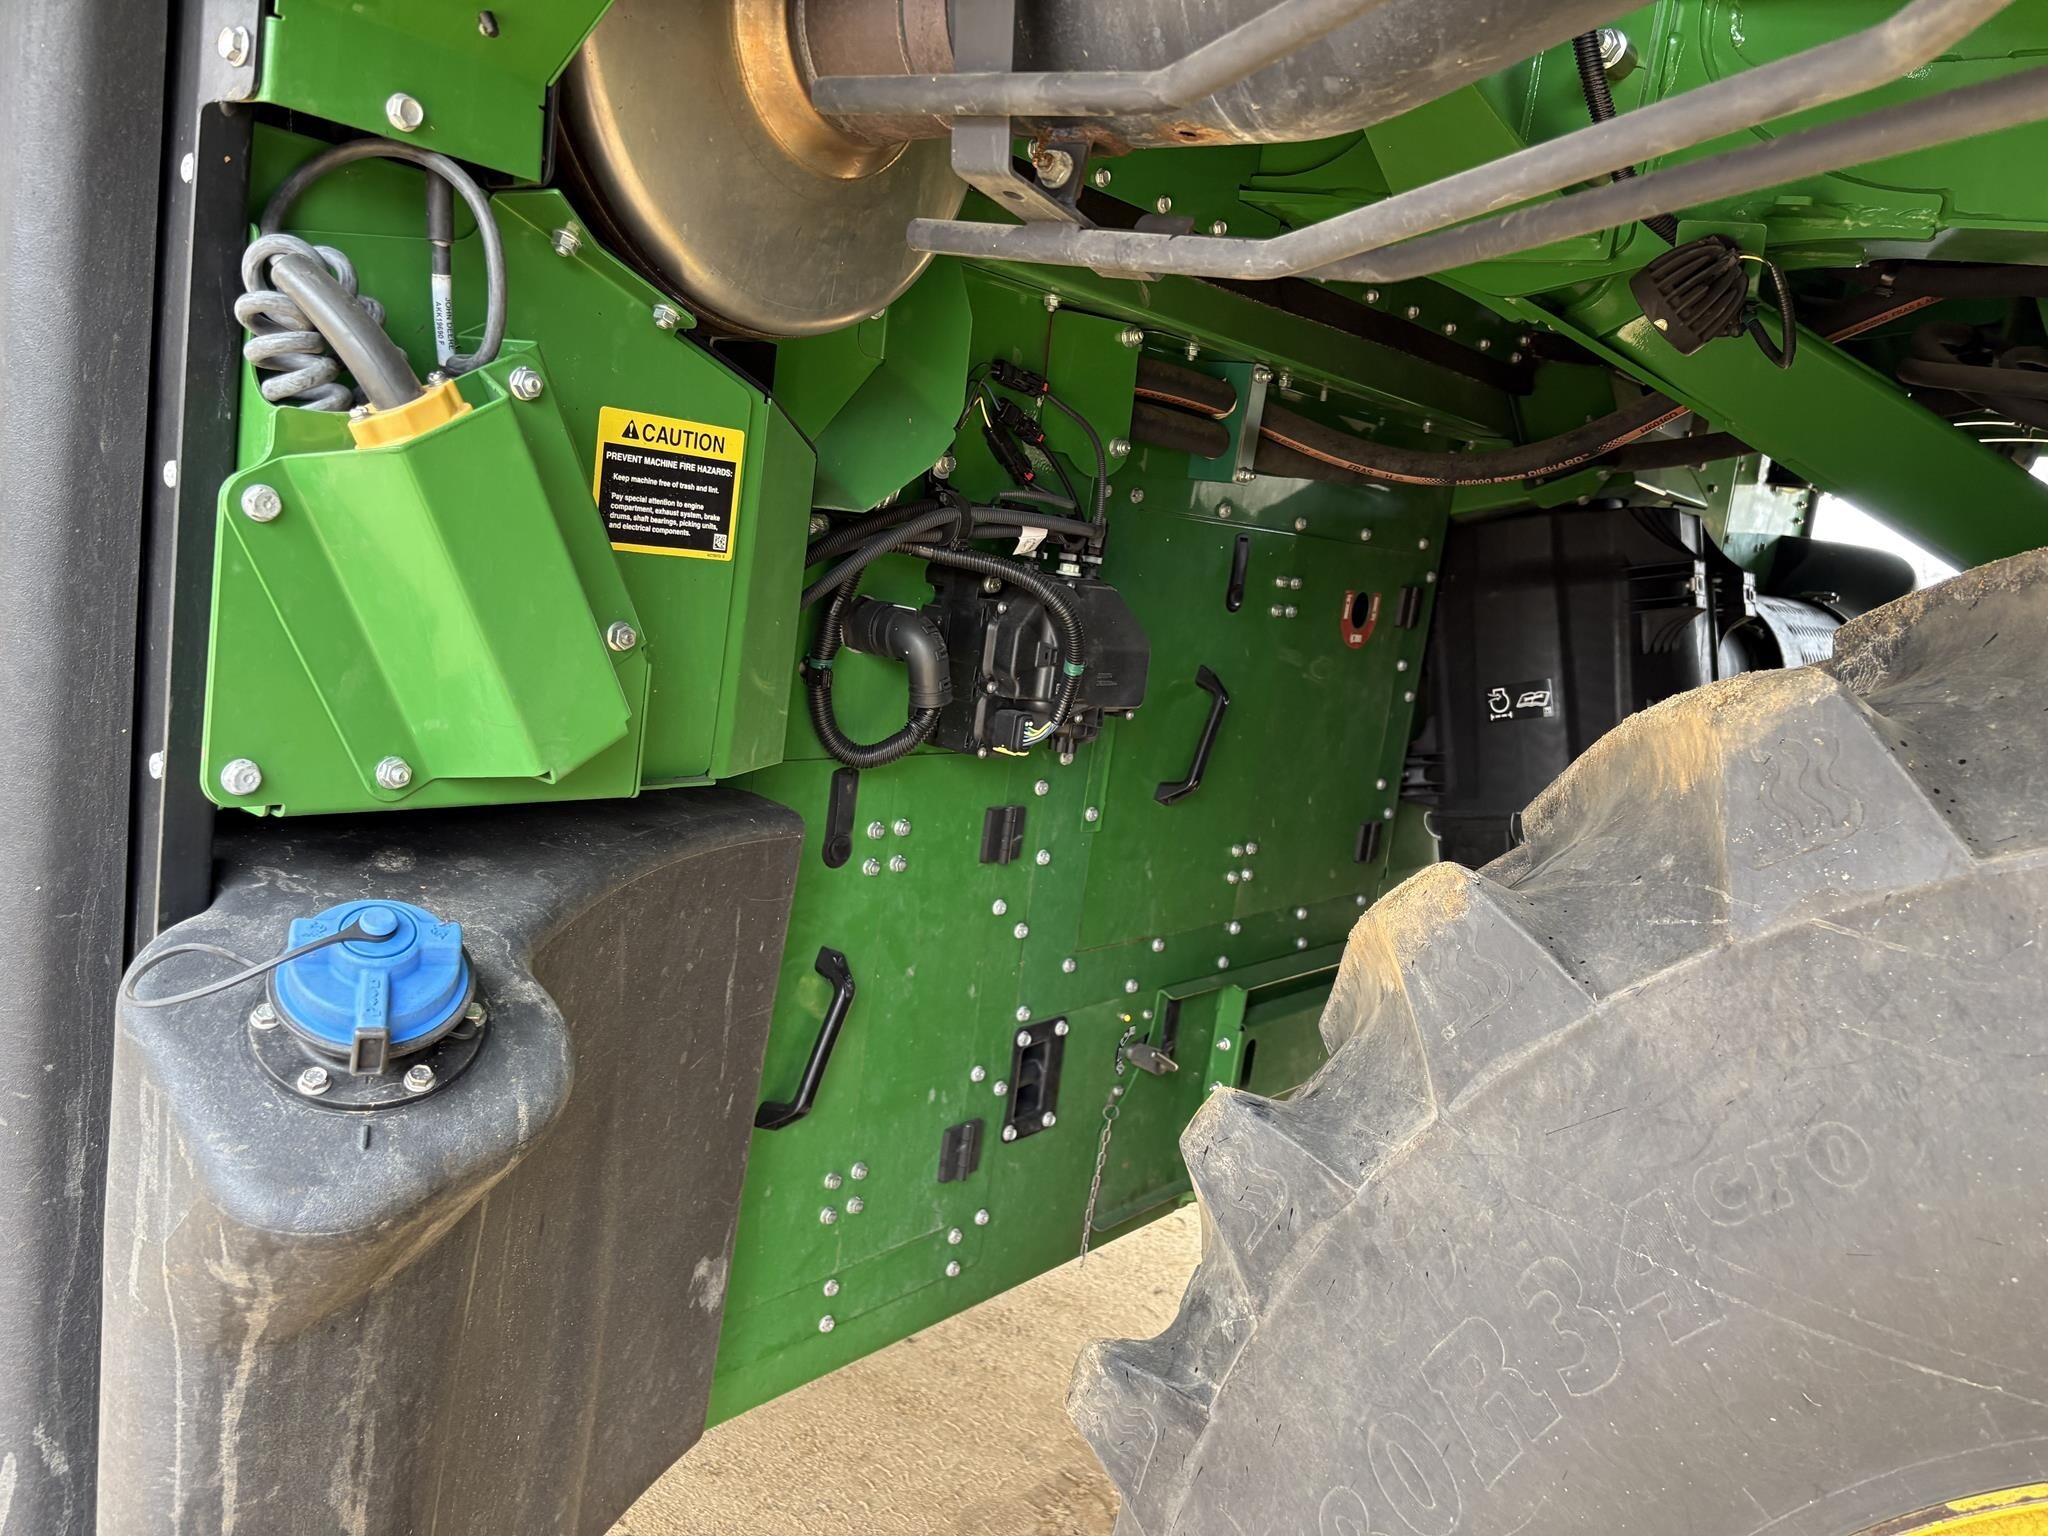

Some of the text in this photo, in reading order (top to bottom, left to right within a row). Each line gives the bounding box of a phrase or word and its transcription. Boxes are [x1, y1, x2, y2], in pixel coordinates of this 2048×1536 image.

[642, 423, 725, 454] CAUTION
[606, 450, 733, 478] PREVENT MACHINE FIRE HAZARDS:
[612, 472, 720, 495] Keep machine free of trash and lint.
[611, 491, 705, 511] Pay special attention to engine
[609, 511, 719, 532] drums, shaft bearings, picking units,
[610, 502, 721, 522] compartment, exhaust system, brake
[608, 521, 691, 537] and electrical components.
